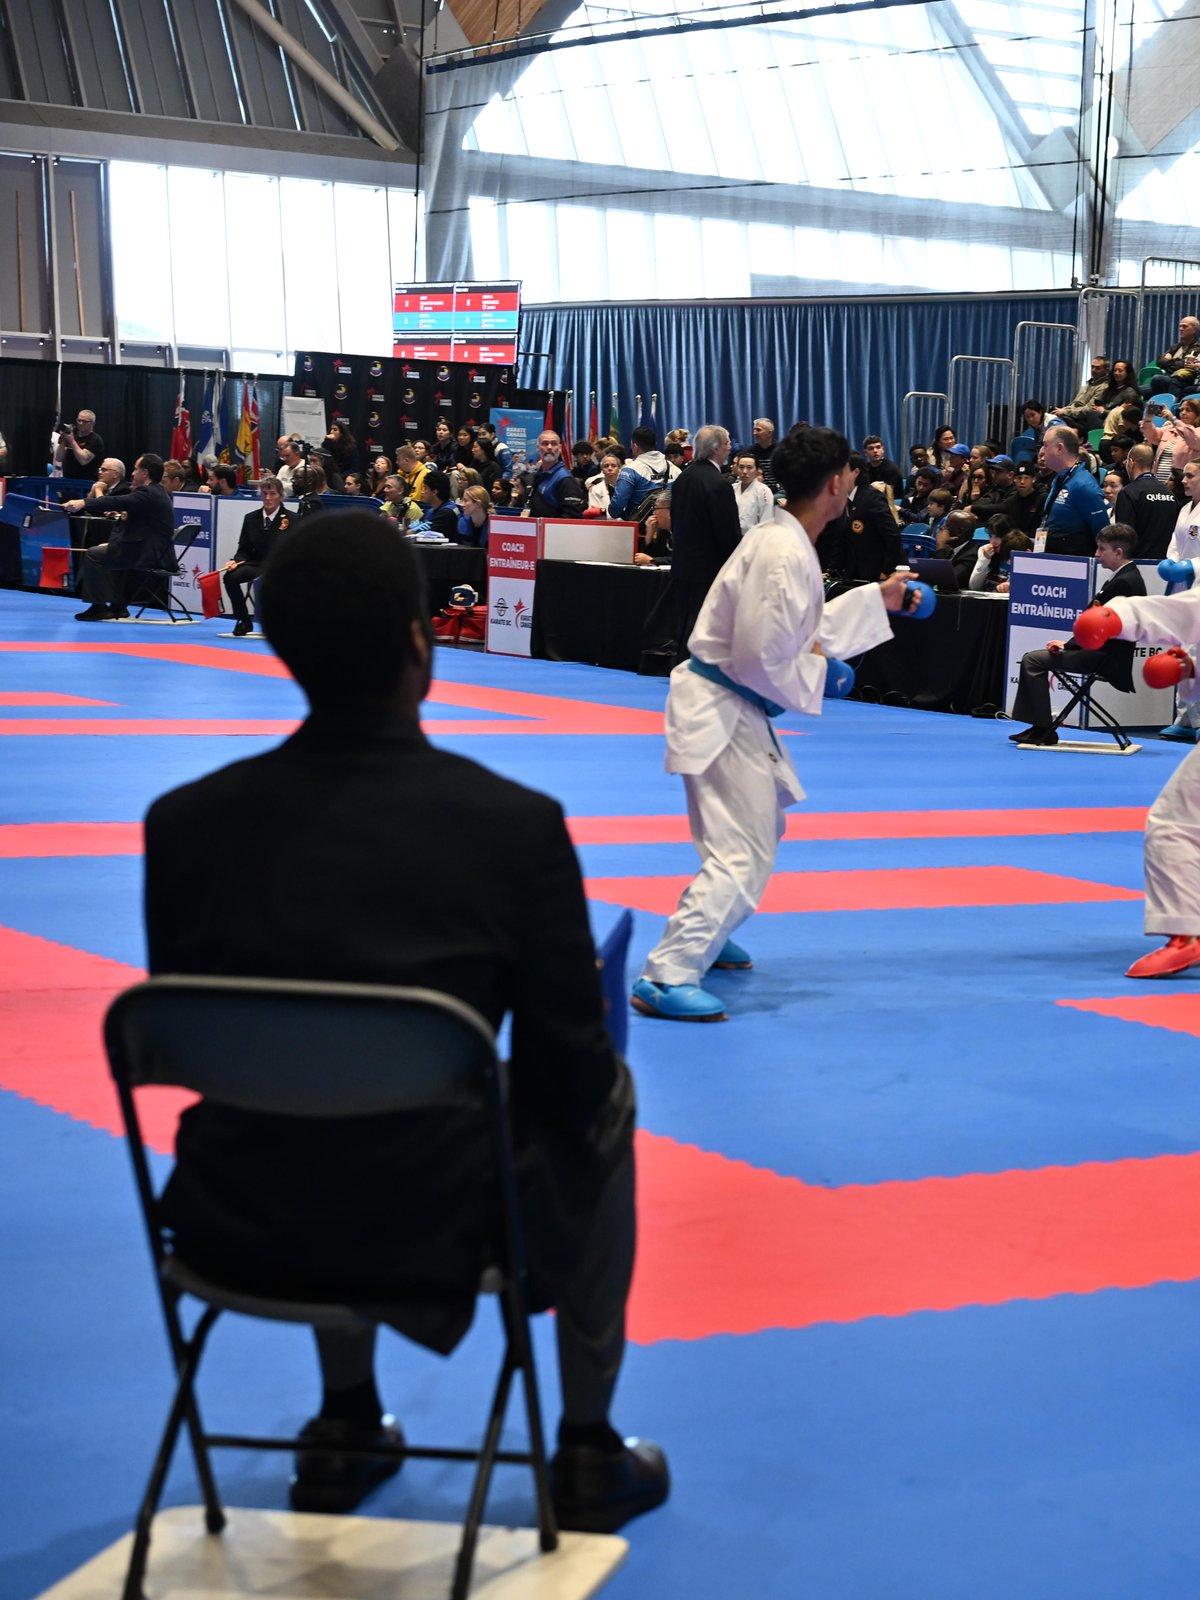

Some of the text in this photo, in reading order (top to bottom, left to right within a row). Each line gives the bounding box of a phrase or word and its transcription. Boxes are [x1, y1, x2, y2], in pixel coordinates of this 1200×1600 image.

[1146, 493, 1175, 502] QUÉBEC
[183, 515, 201, 524] COACH
[502, 542, 525, 553] COACH
[1031, 584, 1067, 599] COACH
